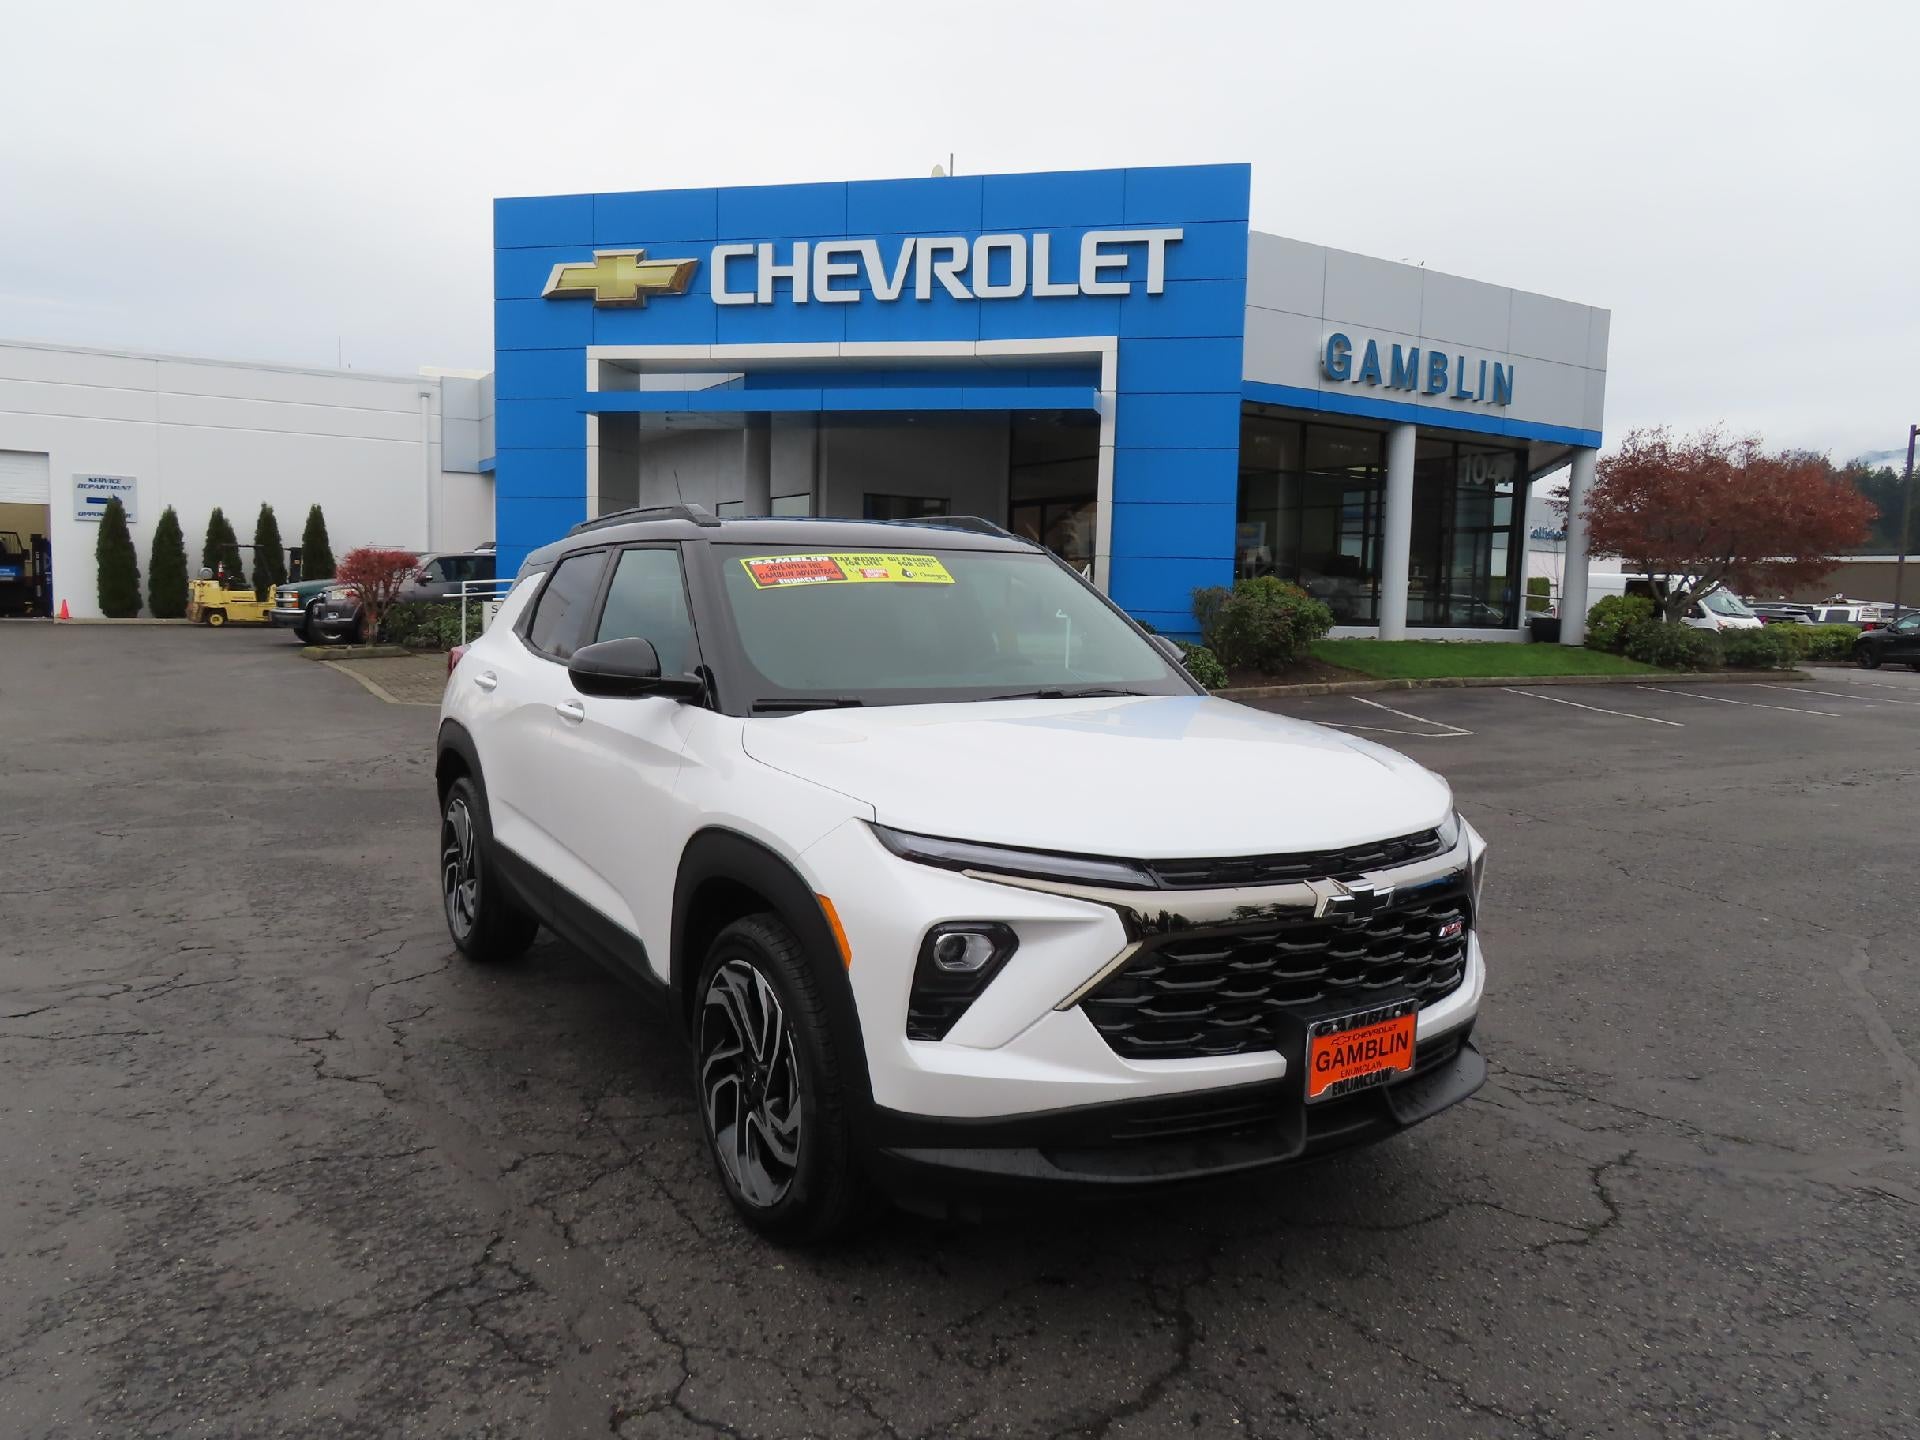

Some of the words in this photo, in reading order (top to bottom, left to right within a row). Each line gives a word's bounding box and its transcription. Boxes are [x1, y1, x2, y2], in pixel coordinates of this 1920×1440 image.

[710, 228, 1184, 305] CHEVROLET
[1321, 332, 1514, 406] GAMBLIN
[77, 483, 132, 491] DEPARTMENT
[1315, 1030, 1409, 1073] GAMBLIN
[1352, 1024, 1398, 1041] CHEVROLET
